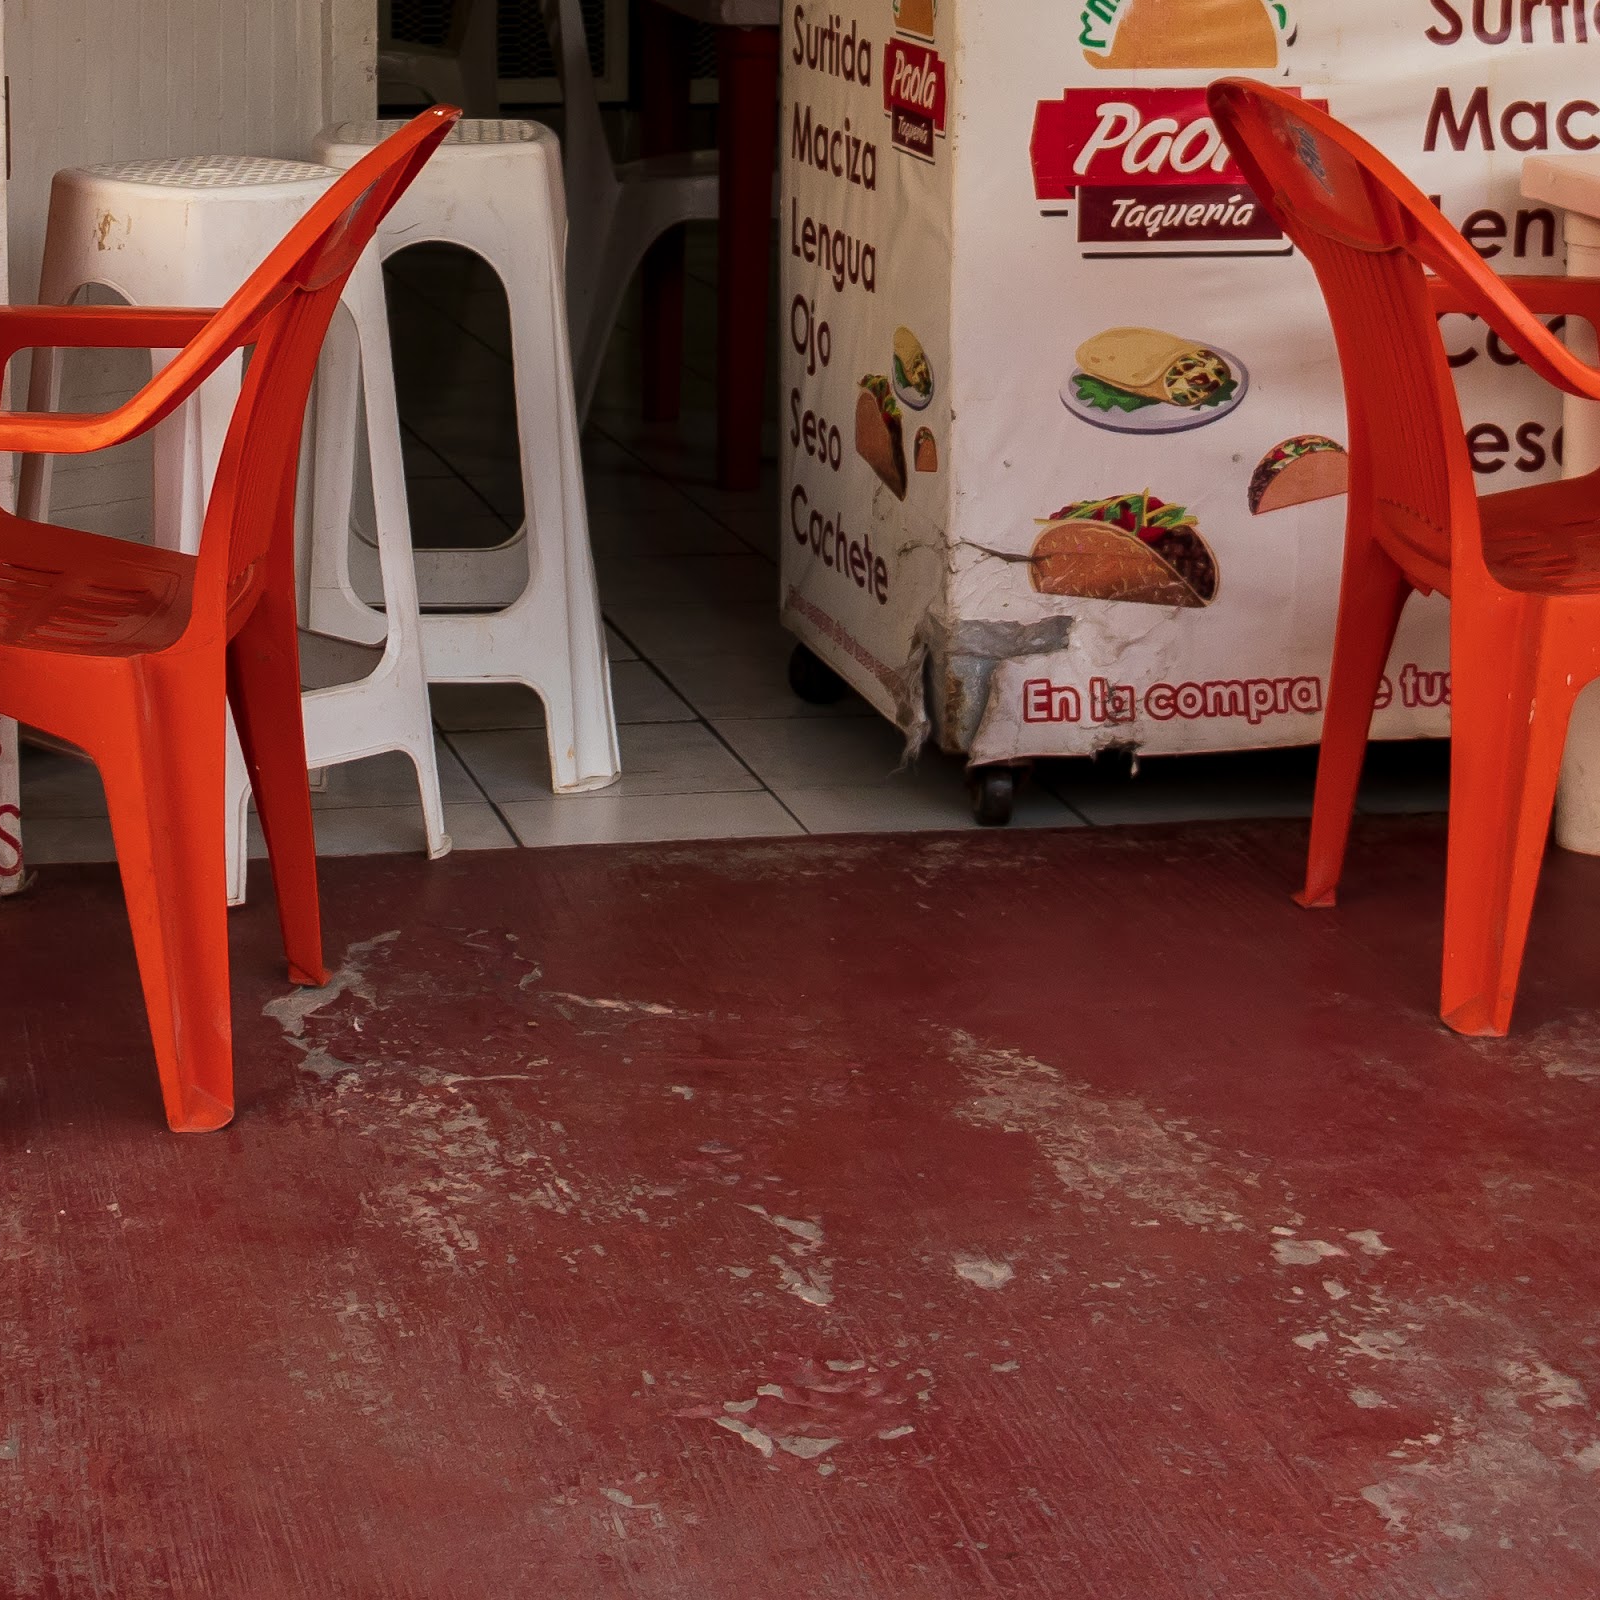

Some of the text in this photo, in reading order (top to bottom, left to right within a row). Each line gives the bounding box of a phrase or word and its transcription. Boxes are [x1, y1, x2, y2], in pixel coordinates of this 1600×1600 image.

[791, 3, 872, 88] Surtida
[890, 49, 937, 110] Paola
[791, 101, 877, 192] Maciza
[1073, 102, 1231, 176] Pao
[791, 196, 876, 293] Lengua
[1111, 194, 1256, 238] Taquería
[791, 293, 832, 377] Ojo
[790, 386, 842, 473] Seso
[790, 483, 889, 605] Cachete
[1023, 678, 1082, 723] En
[1088, 675, 1135, 722] la
[1143, 675, 1323, 725] compra
